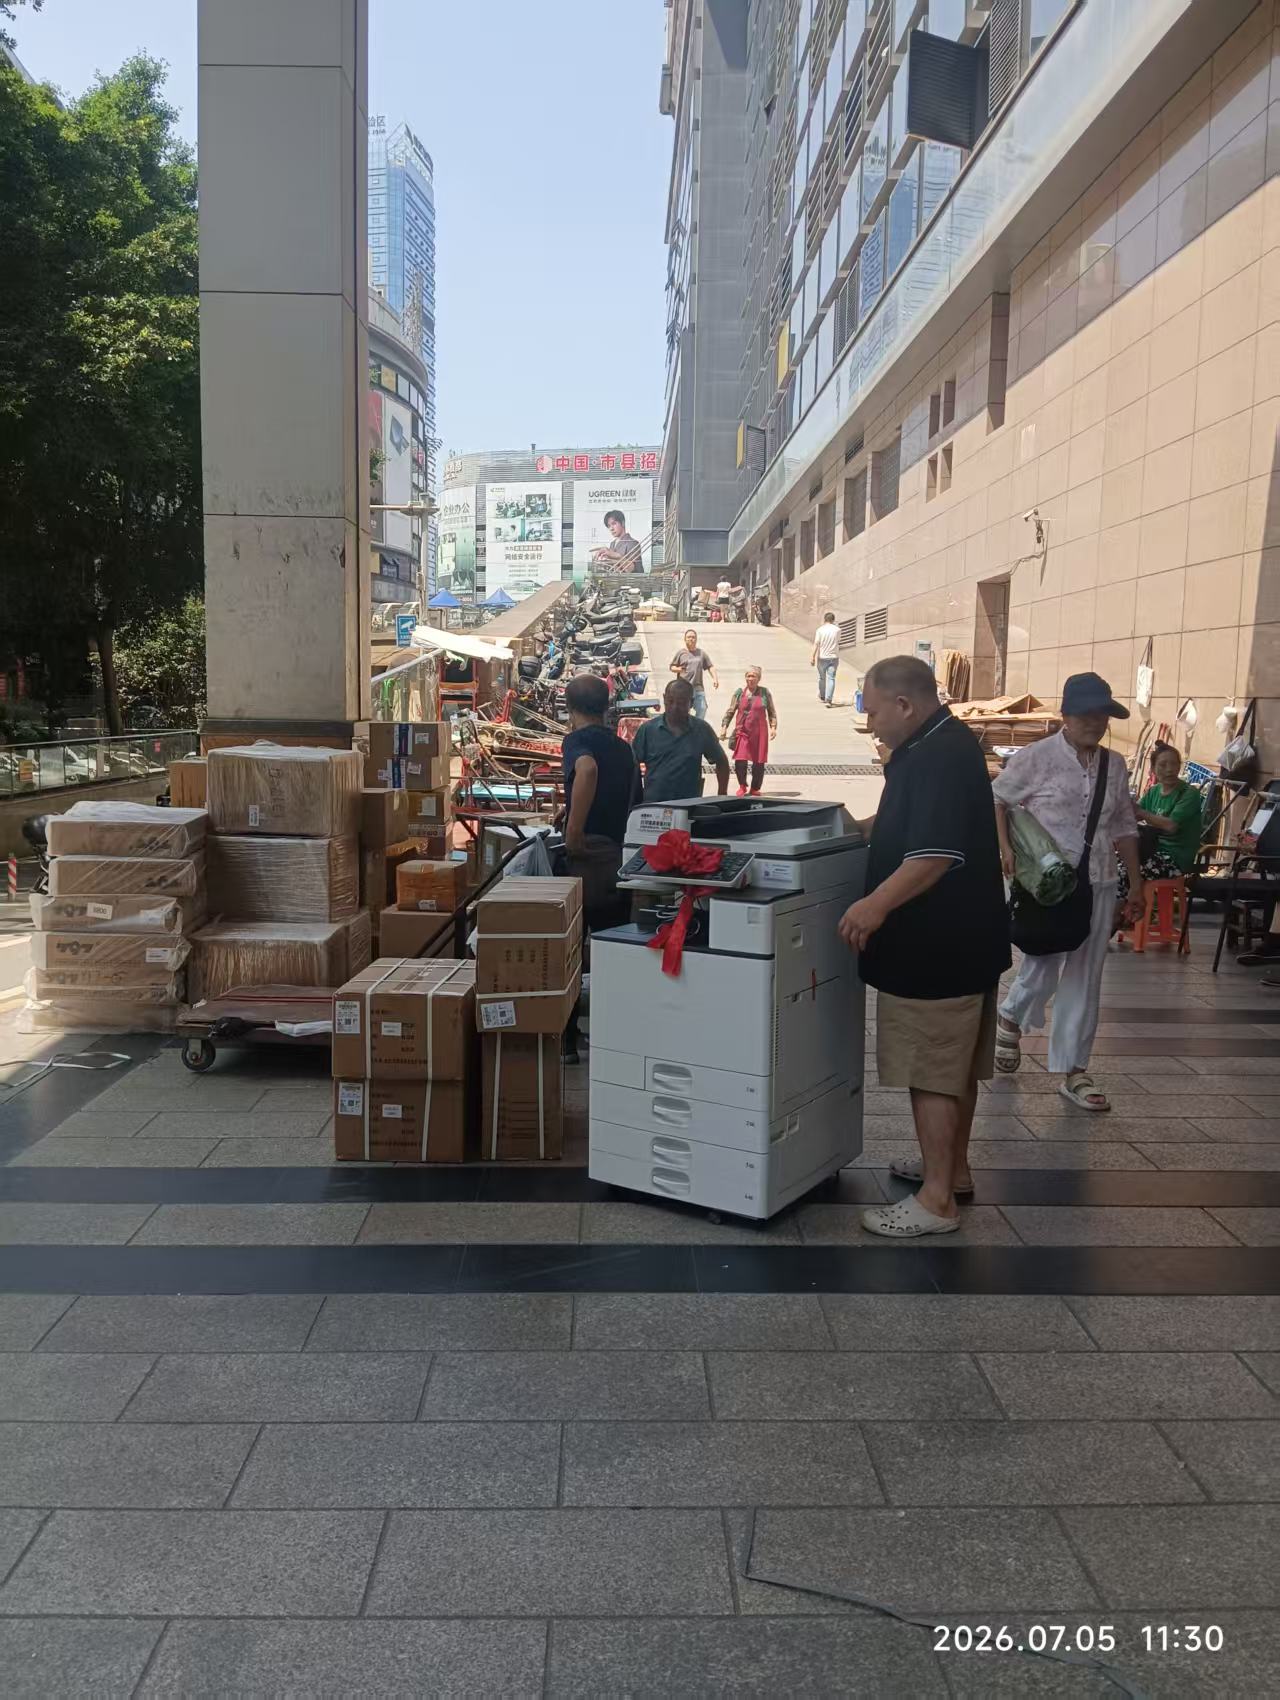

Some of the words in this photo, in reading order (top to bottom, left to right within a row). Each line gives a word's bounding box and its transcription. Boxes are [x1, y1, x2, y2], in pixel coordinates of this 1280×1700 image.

[556, 453, 657, 471] 中国·市县招
[588, 490, 621, 498] UGREEN
